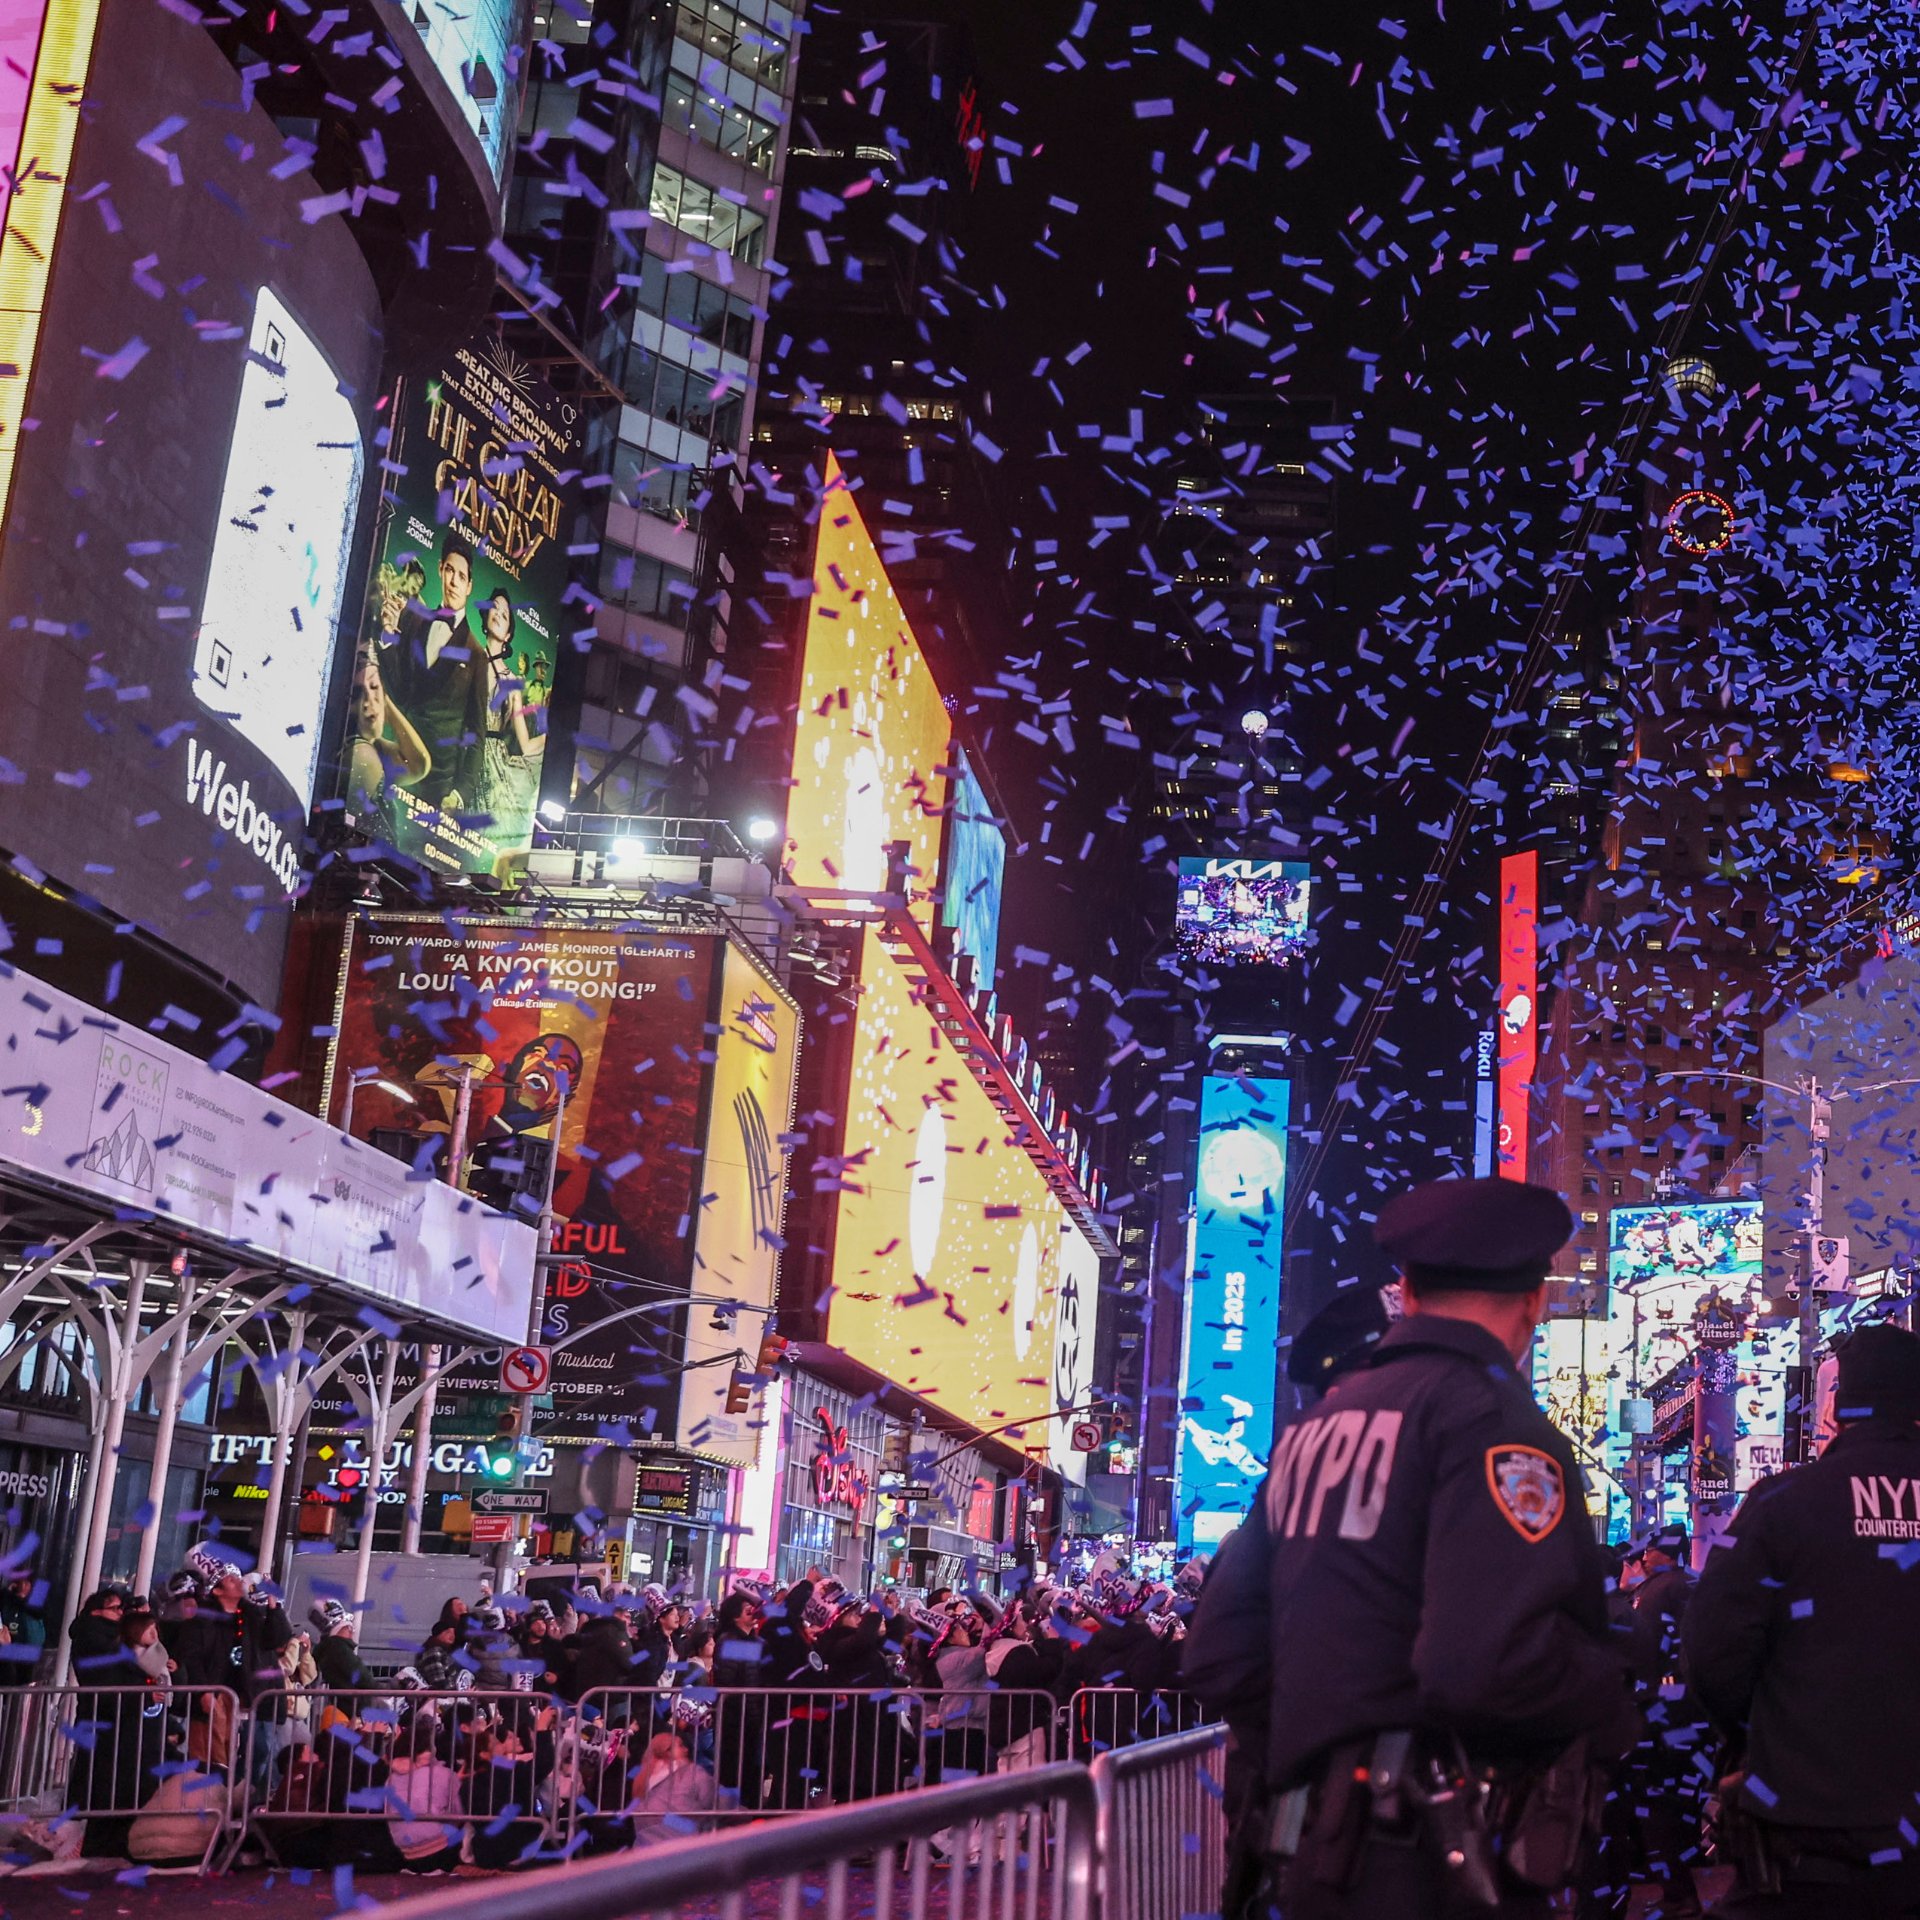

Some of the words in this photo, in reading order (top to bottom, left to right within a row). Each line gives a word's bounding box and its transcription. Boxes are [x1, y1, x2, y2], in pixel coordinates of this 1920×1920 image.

[441, 369, 460, 391] THAT
[459, 387, 494, 422] EXPLODES
[494, 416, 512, 438] WITH
[537, 455, 560, 477] ENERG
[492, 375, 511, 402] BIG
[512, 395, 569, 454] BROADWAY
[427, 393, 478, 470] THE
[479, 440, 567, 541] GREAT
[435, 458, 545, 568] GATSBY
[405, 525, 434, 550] JORDAN
[407, 515, 436, 540] JEREMY
[448, 517, 458, 532] A
[459, 523, 482, 548] NEW
[482, 543, 521, 582] MUSICAL
[516, 608, 550, 639] NOBLEZADA
[529, 607, 541, 622] EVA
[396, 787, 416, 807] THE
[416, 798, 461, 833] BRODWAY
[463, 828, 499, 856] THEATRE
[436, 825, 483, 858] BROADWAY
[435, 850, 462, 870] COMPANY
[368, 934, 403, 946] TONY
[518, 942, 560, 953] JAMES
[562, 944, 617, 956] MONROE
[620, 946, 682, 959] IGLEHART
[684, 949, 697, 960] IS
[478, 955, 618, 978] KNOCKOUT
[479, 976, 657, 1001] AMTRONG!”
[493, 998, 525, 1010] Chicago
[525, 998, 558, 1010] Tribune
[1477, 1030, 1495, 1078] Roku
[101, 1044, 164, 1094] ROCK
[351, 1193, 375, 1209] URBAN
[376, 1203, 412, 1225] UMBRELLA
[1223, 1271, 1246, 1326] 2025
[1701, 1327, 1741, 1339] fitness
[557, 1351, 615, 1370] Musical
[549, 1382, 603, 1395] CTOBER
[310, 1399, 343, 1411] OUIS
[575, 1412, 595, 1422] 254
[598, 1414, 609, 1423] W
[342, 1439, 556, 1477] LUGAE
[1750, 1446, 1784, 1465] NEW
[0, 1470, 48, 1498] PRESS
[1265, 1409, 1404, 1541] NYPD
[232, 1485, 269, 1499] Niko
[482, 1494, 504, 1505] ONE
[514, 1496, 538, 1506] WAY
[814, 1604, 829, 1626] 25
[927, 1612, 945, 1629] 25
[519, 1674, 533, 1686] 25
